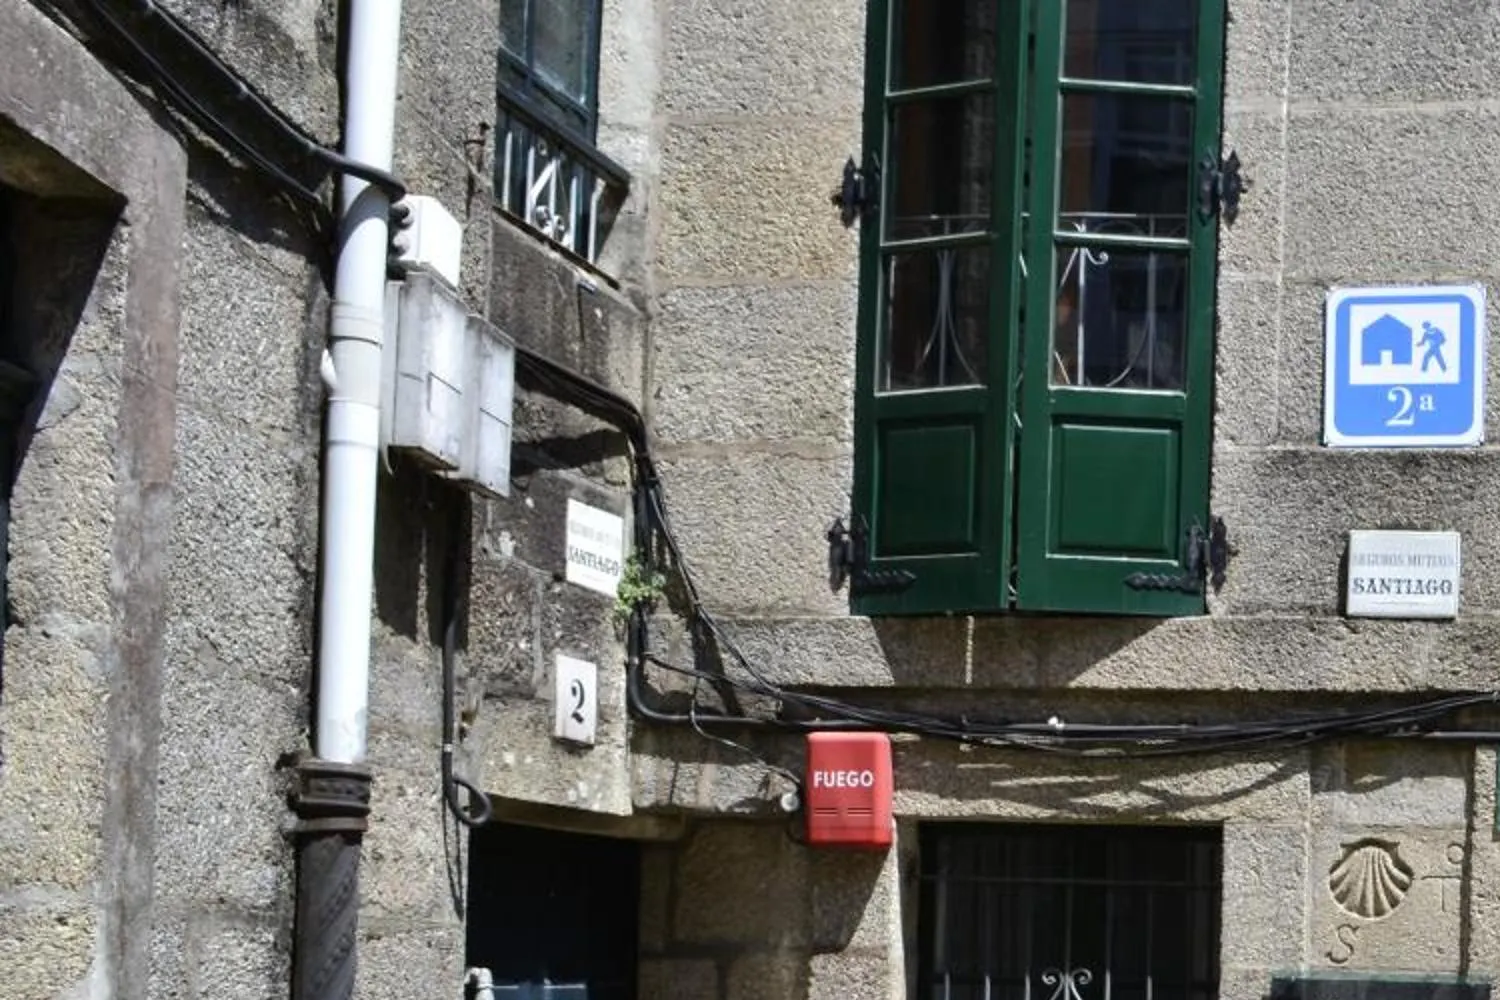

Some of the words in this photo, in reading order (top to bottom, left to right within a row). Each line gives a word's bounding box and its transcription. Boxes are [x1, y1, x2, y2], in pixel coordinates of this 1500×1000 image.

[1352, 578, 1453, 595] SANTIAGO
[570, 678, 585, 724] 2
[813, 770, 874, 788] FUEGO
